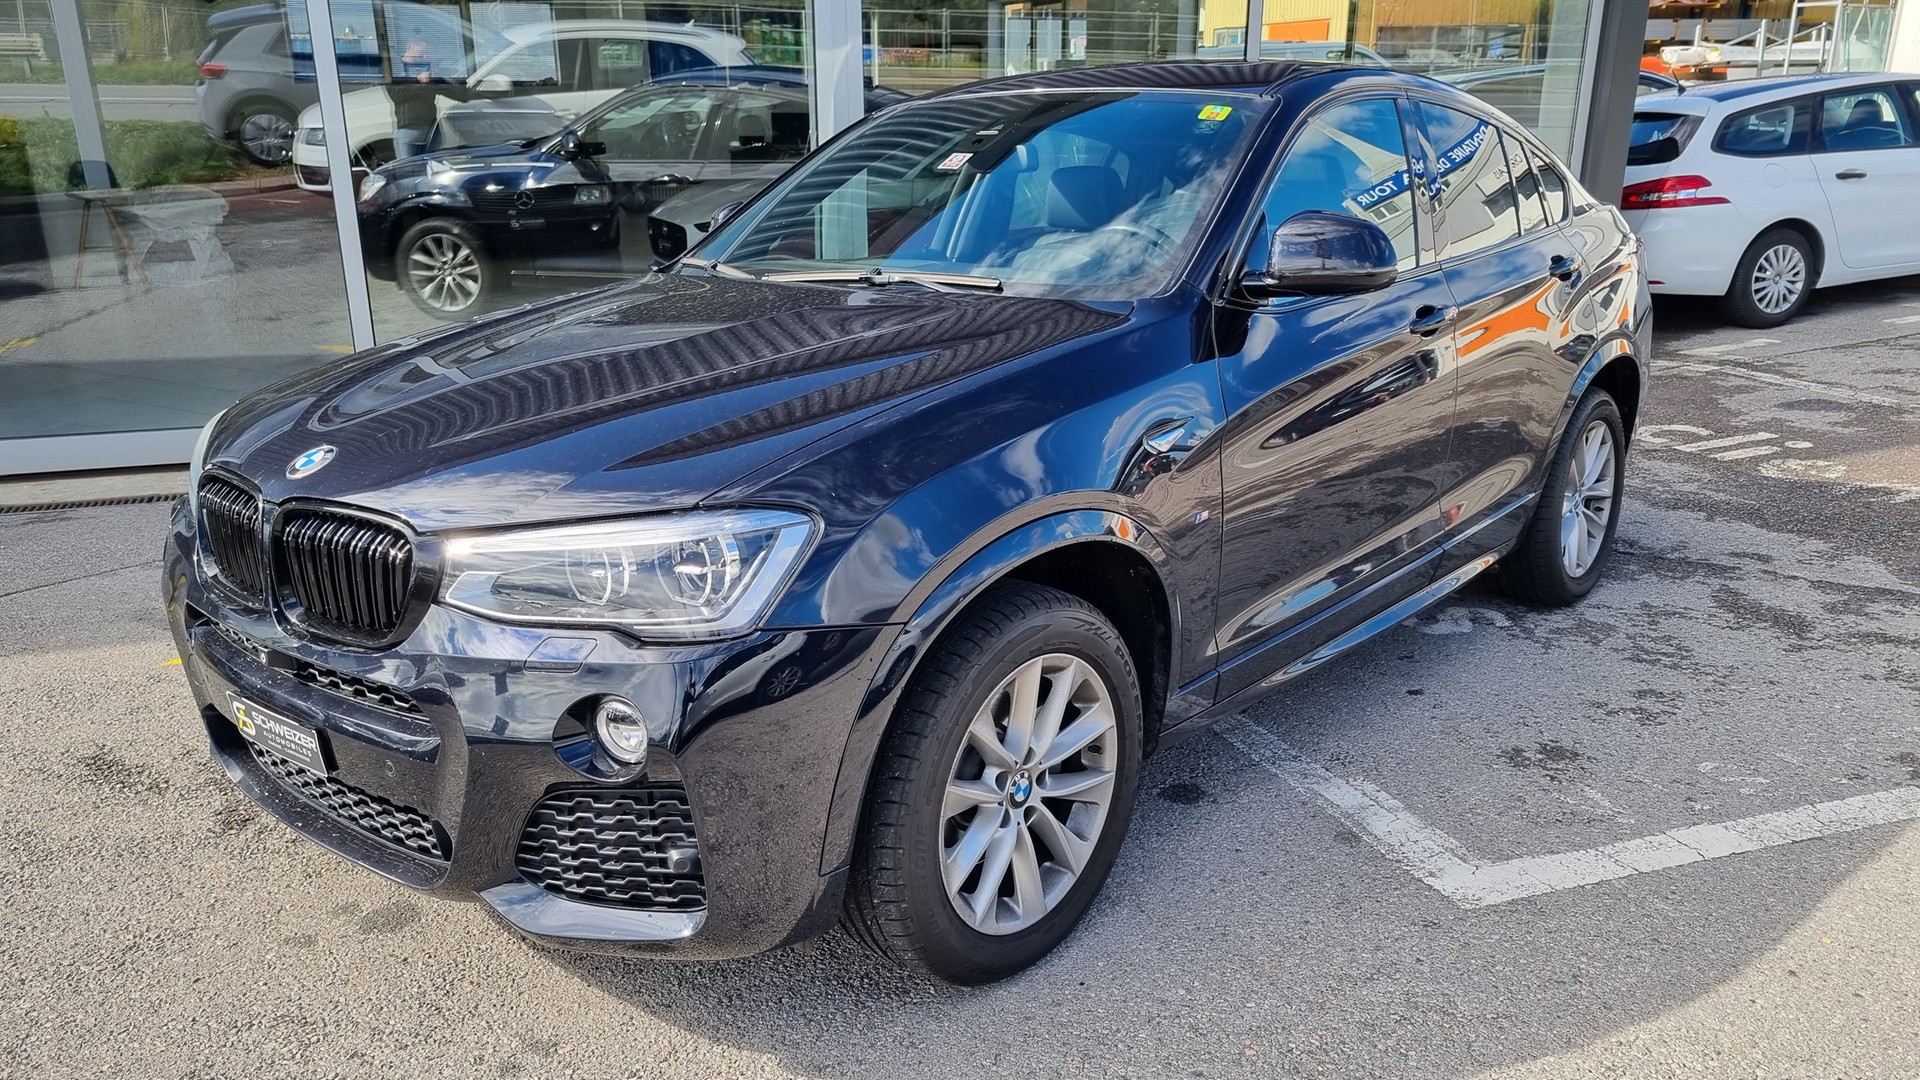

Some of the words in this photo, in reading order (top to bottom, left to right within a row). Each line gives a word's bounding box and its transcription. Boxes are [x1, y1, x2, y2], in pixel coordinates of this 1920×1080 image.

[251, 711, 317, 752] SCHWEIZER
[263, 730, 312, 757] AUTOMOBILES
[1009, 771, 1030, 793] BMW
